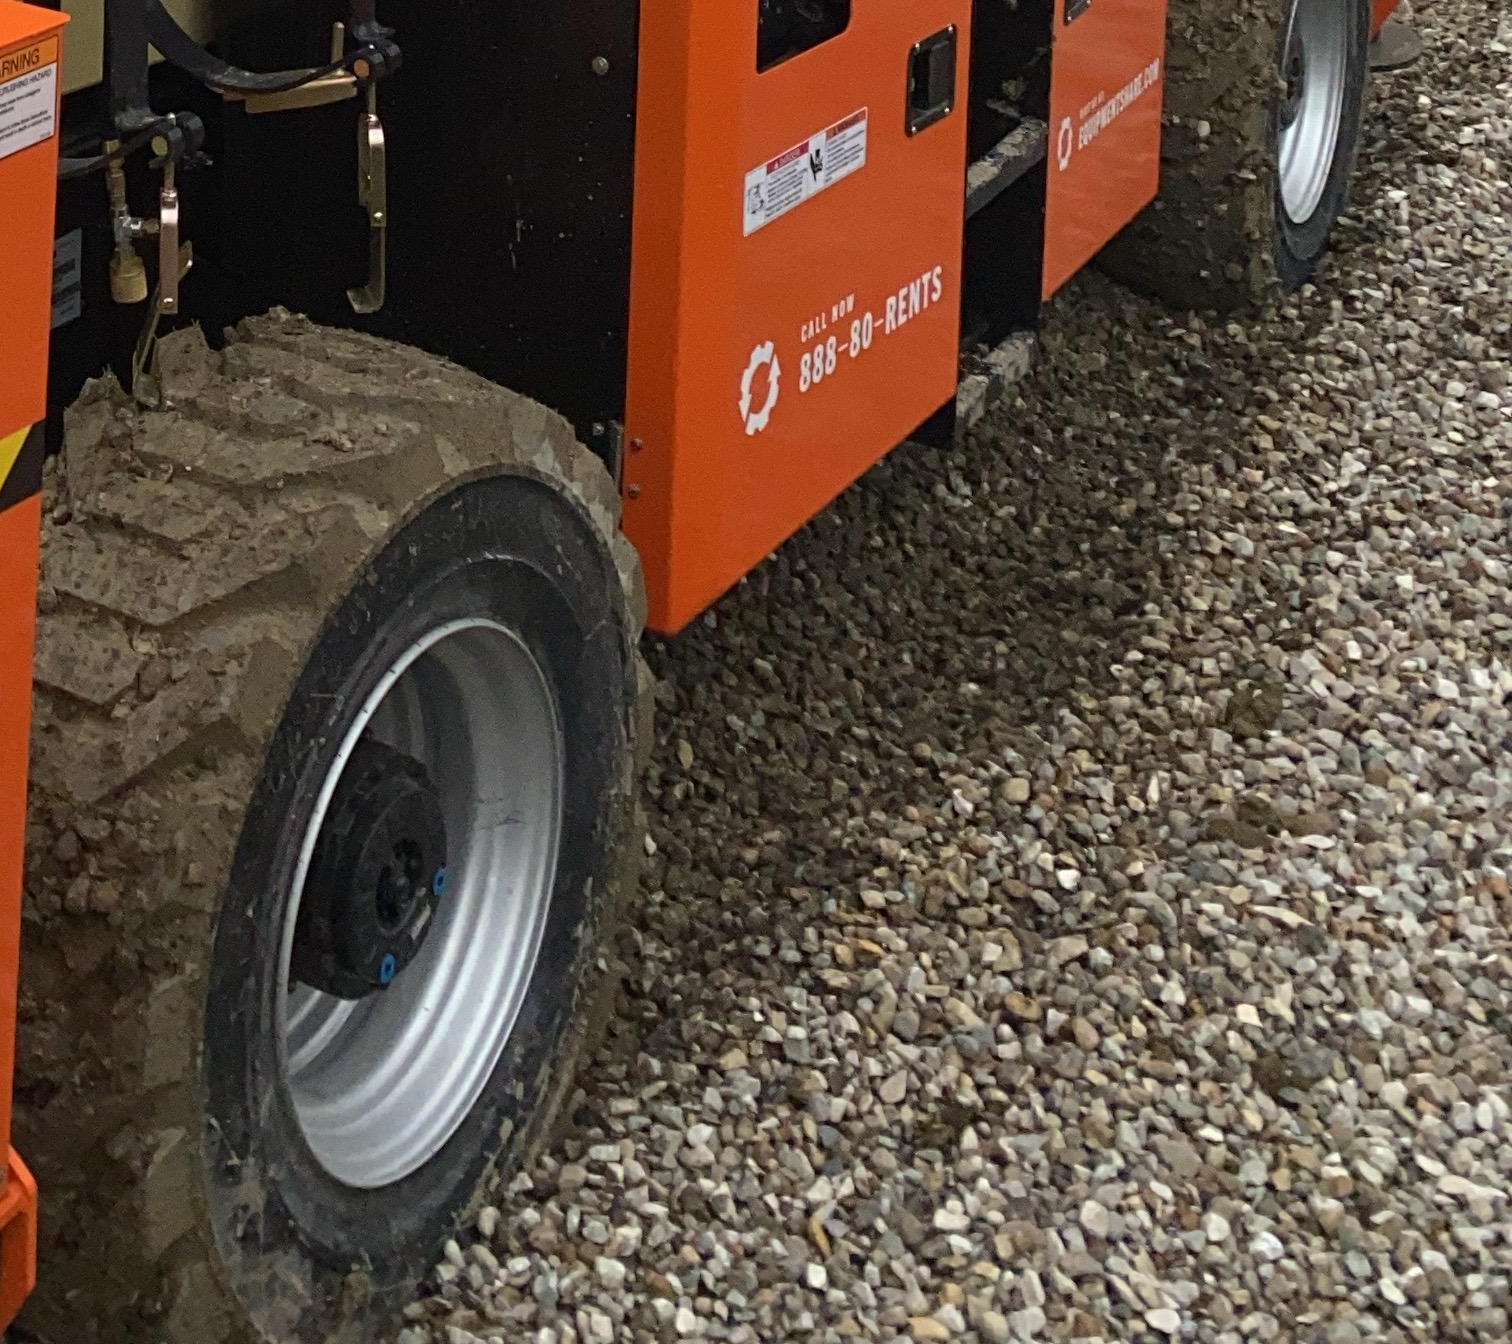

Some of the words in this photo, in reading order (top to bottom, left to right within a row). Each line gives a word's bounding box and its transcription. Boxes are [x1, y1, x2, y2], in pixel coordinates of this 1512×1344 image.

[799, 265, 943, 393] 888-80-RENTS
[800, 311, 827, 343] CALL
[831, 293, 855, 323] NOW
